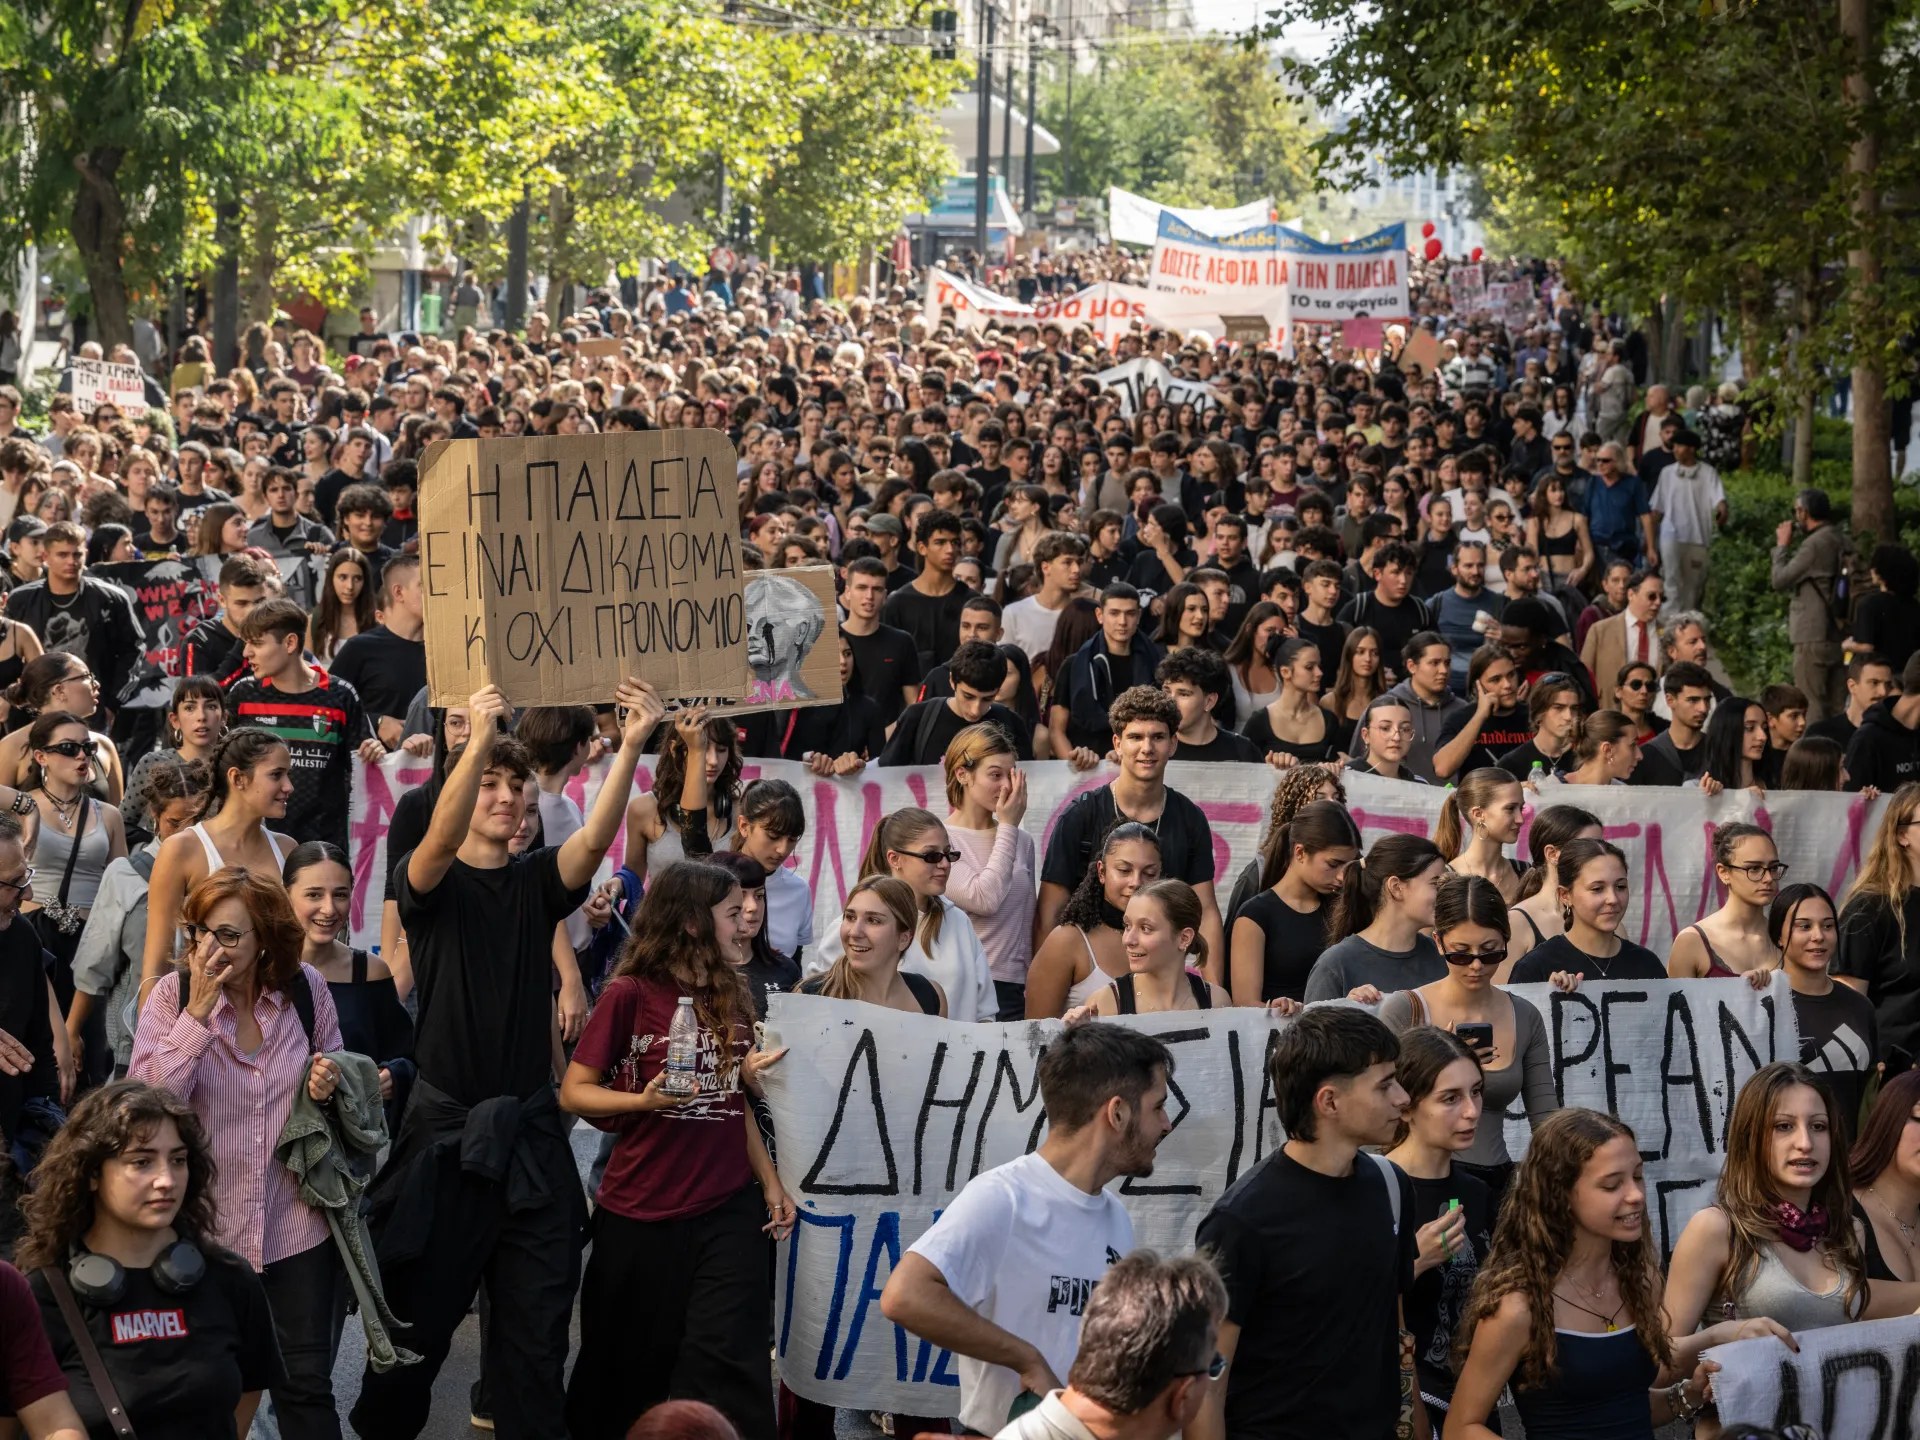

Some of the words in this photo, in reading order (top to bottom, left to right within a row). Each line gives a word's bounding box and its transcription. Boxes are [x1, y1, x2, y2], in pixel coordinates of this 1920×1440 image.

[1206, 257, 1259, 286] ΛΕΦΤΑ
[1296, 261, 1329, 289] ΤΗΝ
[1335, 259, 1397, 290] ΠΑΙΔΕΙΑ
[466, 463, 501, 526] Η
[526, 456, 723, 523] ΠΑΙΔΕΙΑ
[426, 531, 542, 600] ΕΙΝΑΙ
[560, 530, 737, 594] ΔΙΚΑΙΩΜΑ
[506, 605, 575, 667] ΟΧΙ
[594, 592, 744, 659] ΠΡΟΝΟΜΙΟ
[1504, 990, 1777, 1160] ΡΕΑΝ
[114, 1312, 187, 1341] MARVEL
[1047, 1275, 1101, 1317] PU
